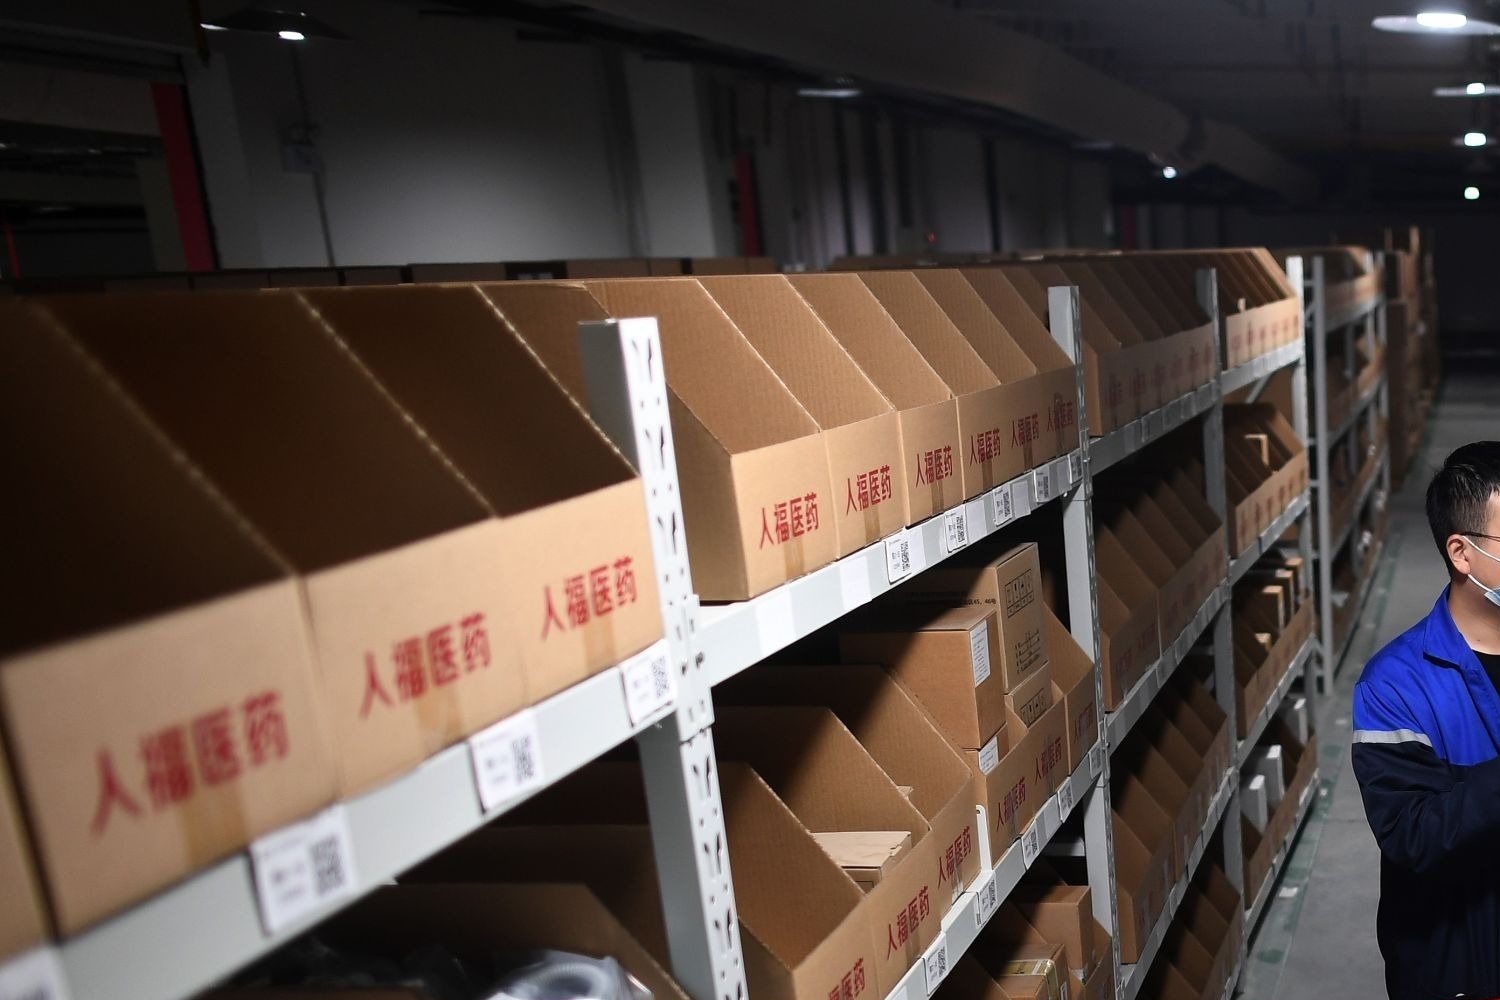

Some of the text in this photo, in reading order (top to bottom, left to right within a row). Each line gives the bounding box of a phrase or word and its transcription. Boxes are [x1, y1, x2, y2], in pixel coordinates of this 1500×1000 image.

[969, 427, 1000, 466] 人福医药
[1010, 414, 1039, 449] 人福医药
[846, 465, 892, 516] 人福医药
[915, 446, 952, 488] 人福医药
[759, 492, 820, 550] 人福医药
[539, 556, 637, 641] 人福医药
[358, 612, 491, 719] 人福医药
[91, 690, 289, 837] 人福医药
[996, 776, 1026, 832] 人福医药
[937, 826, 972, 889] 人福医药
[887, 886, 930, 960] 人福医药
